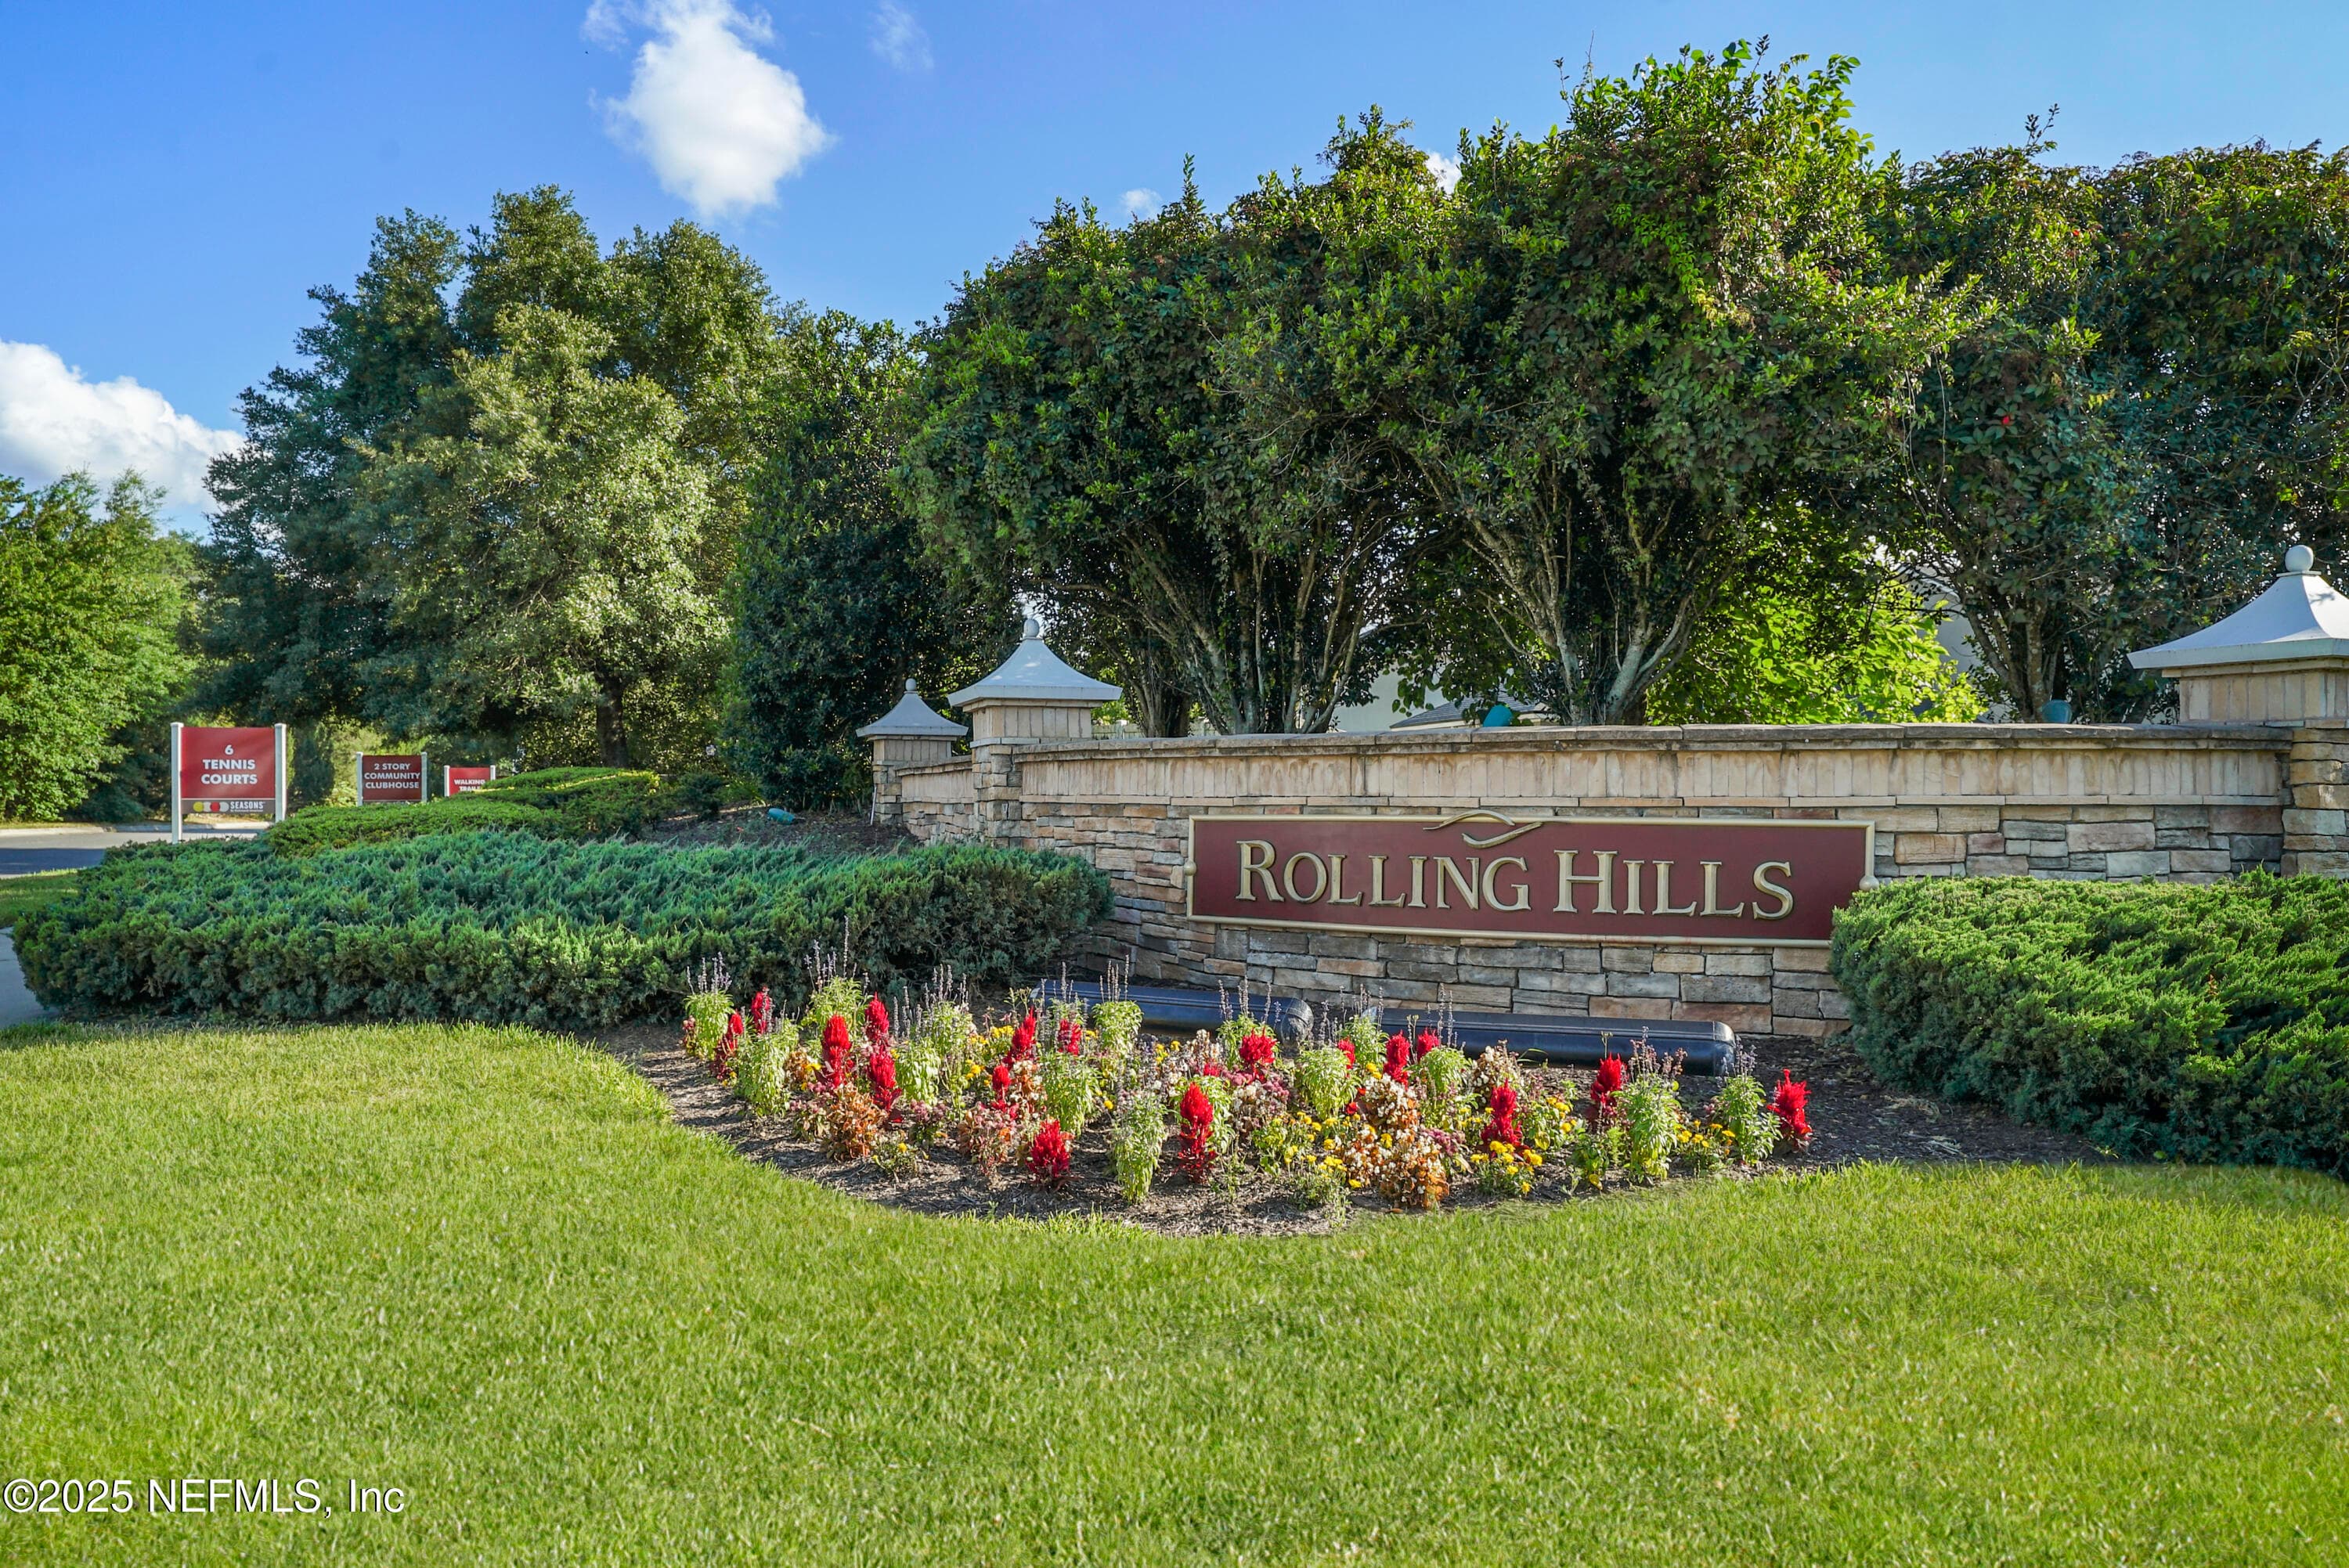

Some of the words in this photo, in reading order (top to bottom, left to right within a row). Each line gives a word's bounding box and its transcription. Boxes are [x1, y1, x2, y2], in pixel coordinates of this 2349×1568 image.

[225, 744, 233, 755] 6
[203, 759, 255, 770] TENNIS
[201, 774, 258, 784] COURTS
[1235, 839, 1532, 912] ROLLING
[1552, 849, 1795, 920] HILLS
